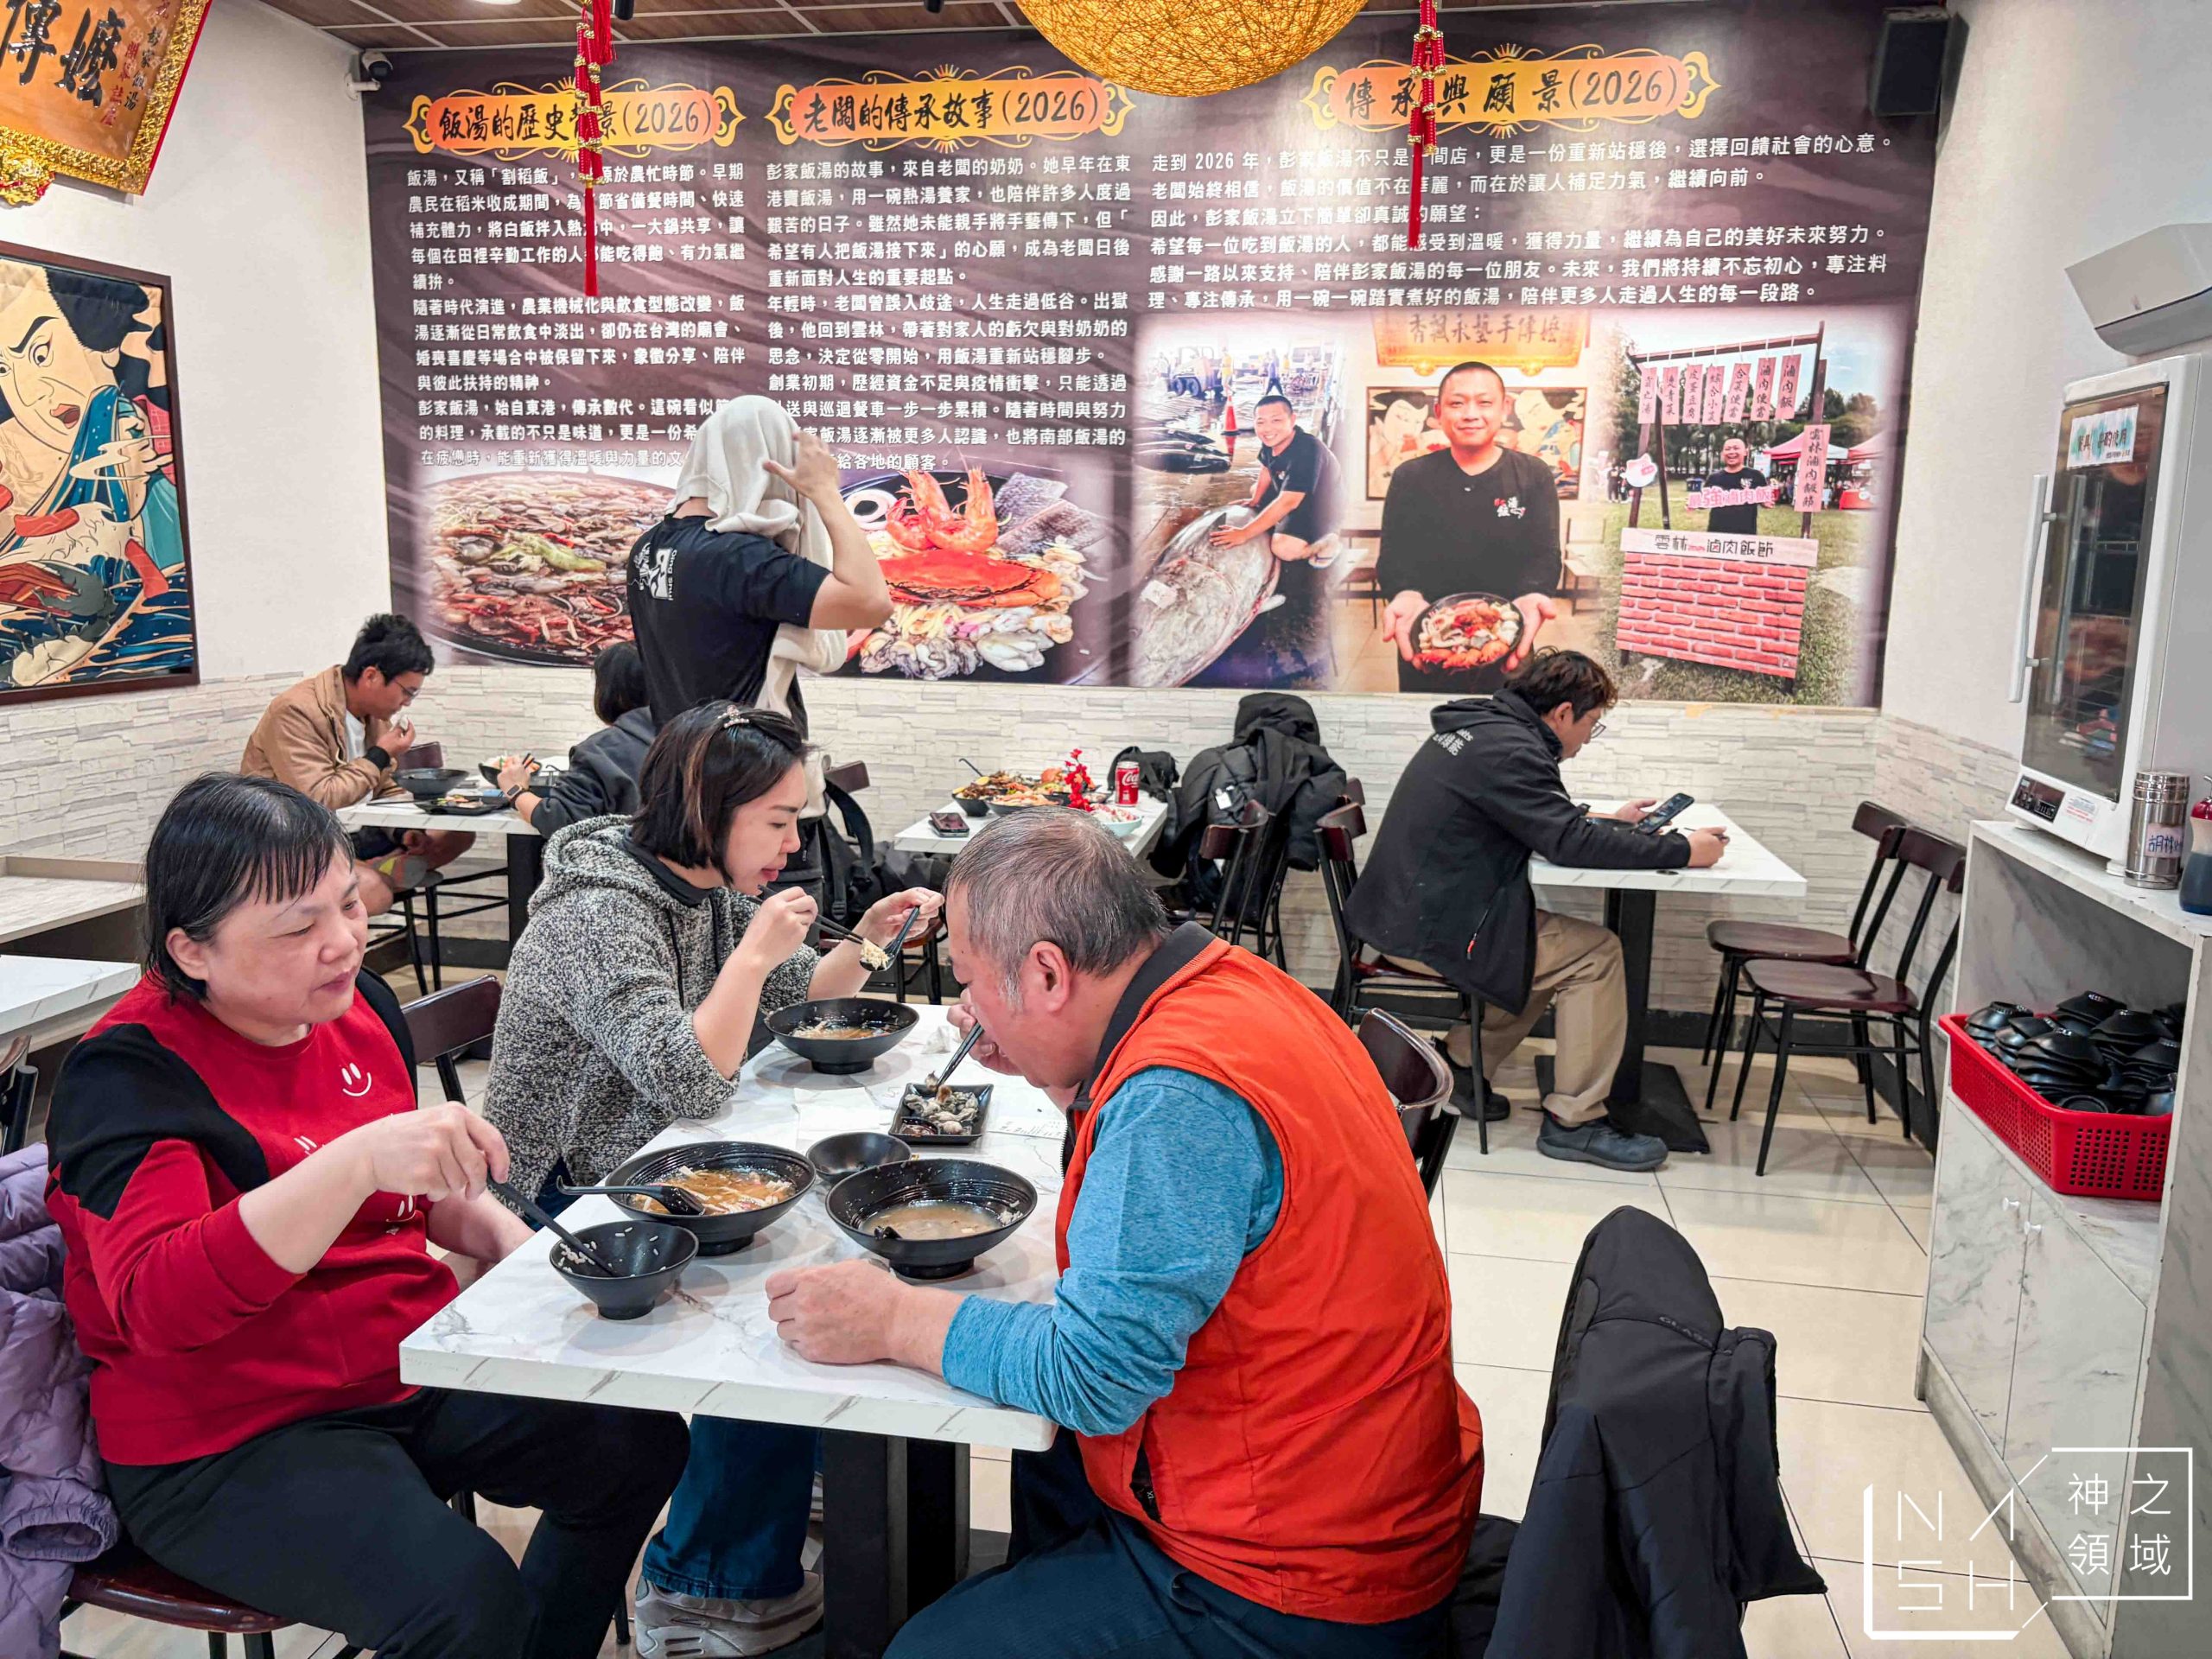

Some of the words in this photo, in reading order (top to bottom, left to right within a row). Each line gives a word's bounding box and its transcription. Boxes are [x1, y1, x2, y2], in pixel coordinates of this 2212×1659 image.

[804, 86, 1099, 133] 老闆的傳承故事(2026)
[1152, 153, 1187, 172] 走到
[1195, 151, 1234, 170] 2026
[407, 163, 744, 186] 飯湯，又稱「割稻飯」，源於農忙時節。早期
[409, 189, 744, 213] 農民在稻米收成期間，為節省備餐時間、快速
[767, 267, 967, 288] 重新面對人生的重要起點。
[417, 374, 551, 391] 與彼此扶持的精神。
[777, 400, 1126, 419] 送與巡迴餐車一步一步累積。隨著時間與努力
[830, 453, 950, 472] 給各地的顧客。
